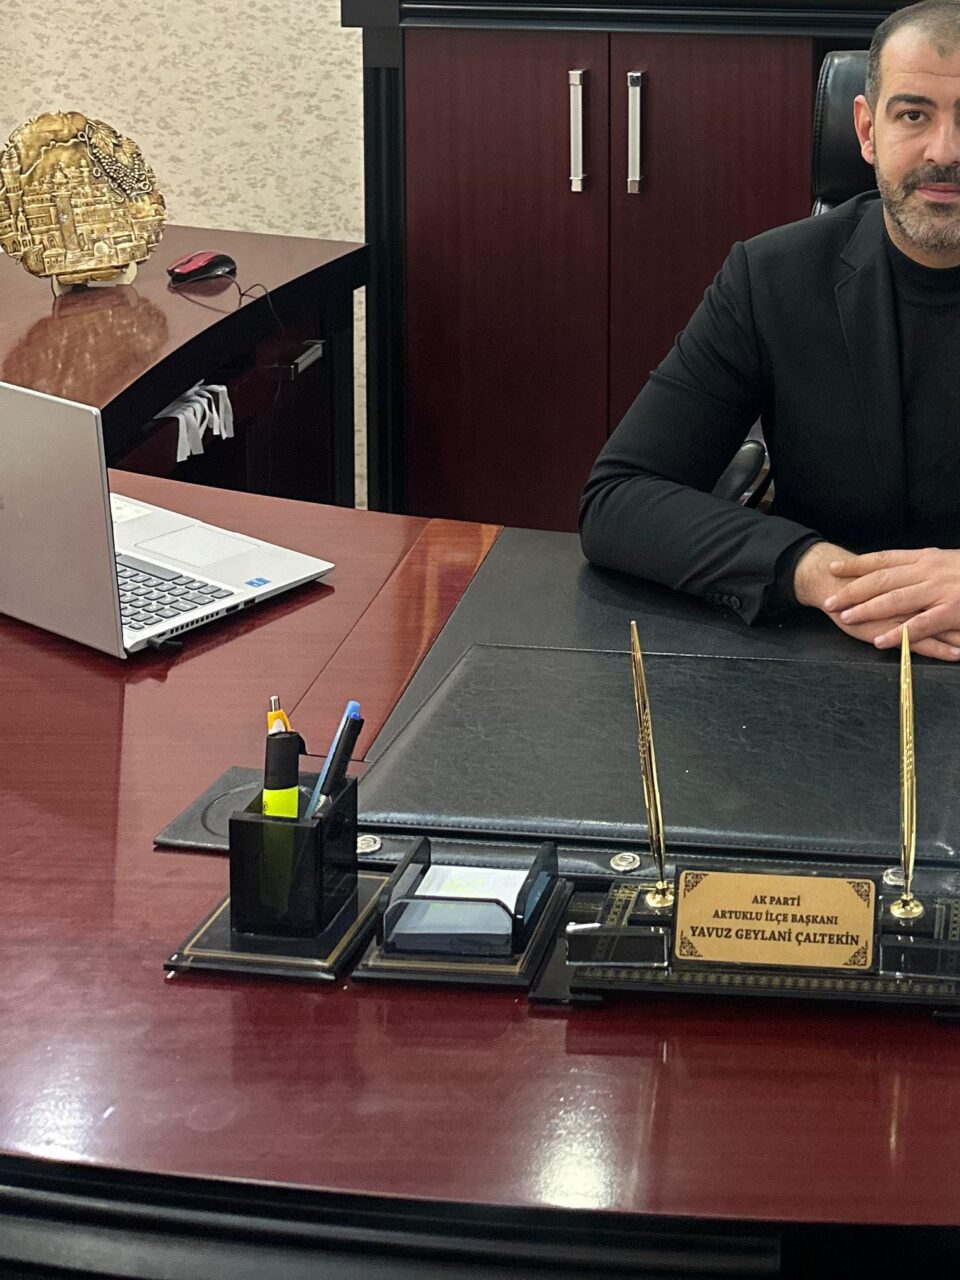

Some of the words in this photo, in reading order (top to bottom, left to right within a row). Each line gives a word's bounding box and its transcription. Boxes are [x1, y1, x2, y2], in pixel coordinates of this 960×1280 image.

[752, 895, 767, 905] AK
[769, 895, 800, 906] PARTİ
[713, 909, 763, 921] ARTUKLU
[765, 910, 788, 924] İLÇE
[791, 914, 838, 927] BAŞKANI
[690, 926, 732, 939] YAVUZ
[735, 928, 792, 942] GEYLANİ
[795, 931, 860, 946] ÇALTEKİN
